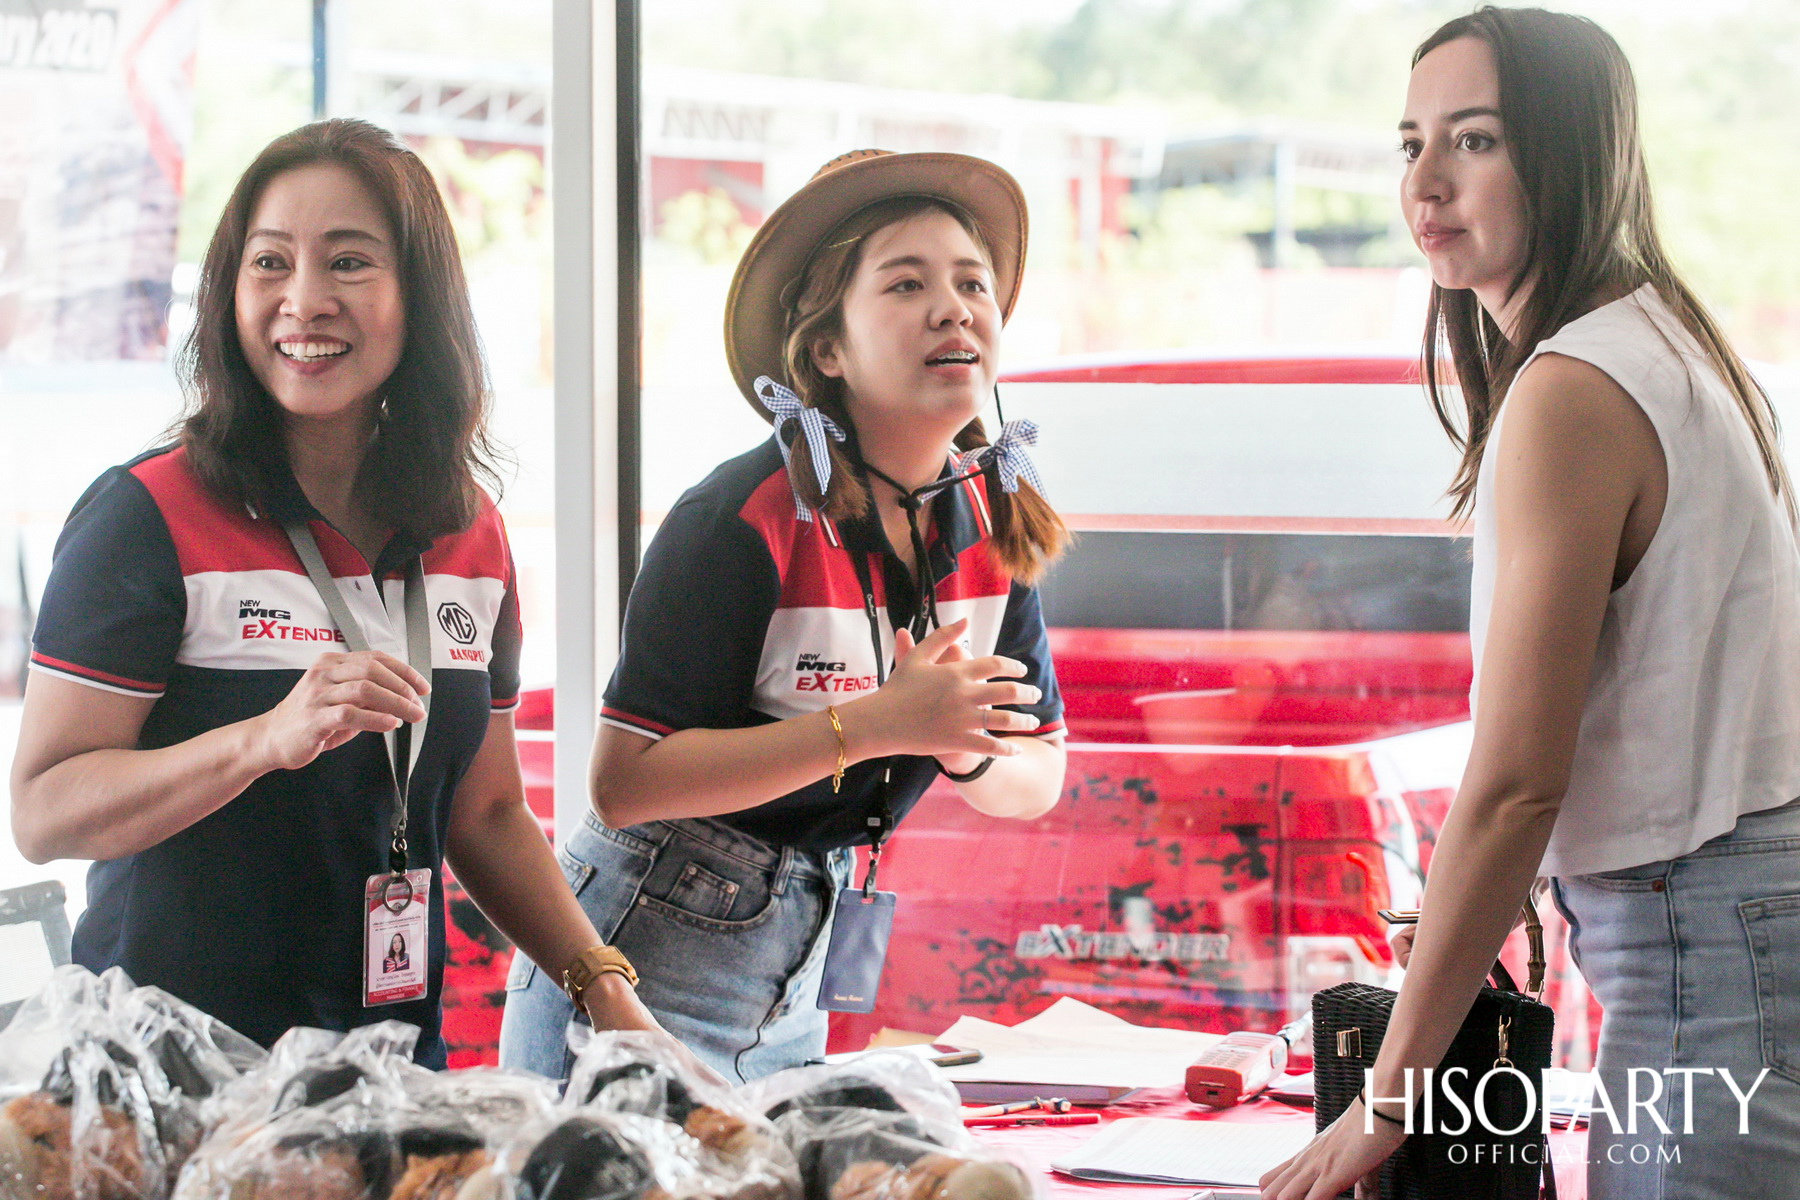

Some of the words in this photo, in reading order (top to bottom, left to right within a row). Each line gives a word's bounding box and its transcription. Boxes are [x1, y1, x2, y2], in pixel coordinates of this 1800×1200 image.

[239, 608, 291, 620] MG
[439, 607, 473, 639] MG
[449, 648, 485, 662] BANGPU
[796, 661, 846, 671] MG
[1015, 924, 1231, 961] EXTENDER
